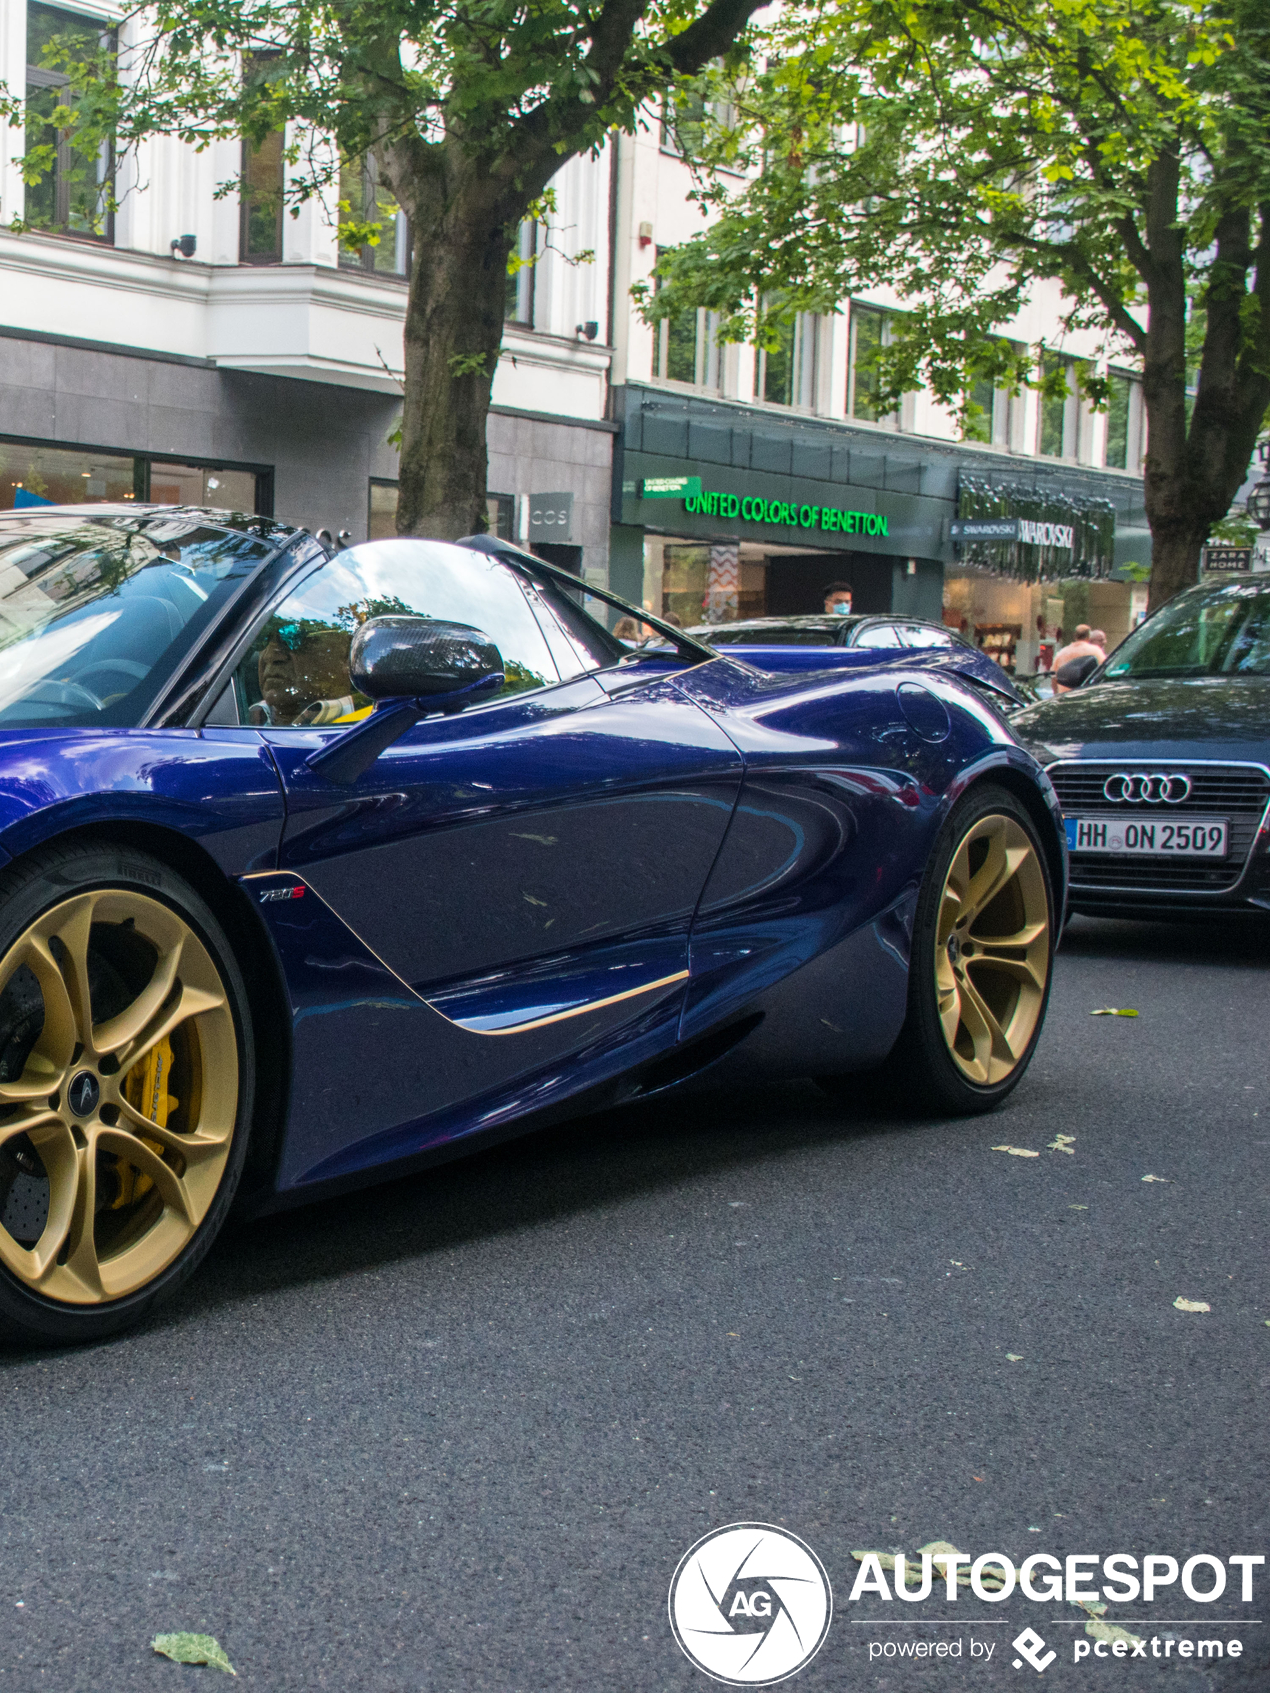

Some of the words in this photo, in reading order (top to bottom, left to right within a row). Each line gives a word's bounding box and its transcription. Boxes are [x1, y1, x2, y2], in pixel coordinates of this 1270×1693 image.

[532, 510, 567, 525] COS
[684, 491, 740, 518] UNITED
[741, 496, 798, 526] COLORS
[799, 504, 819, 528] OF
[963, 524, 1017, 535] SWAROVSKI
[1018, 518, 1074, 549] WAROVSKI
[1211, 551, 1246, 560] ZARA
[1210, 561, 1245, 569] HOME
[1079, 823, 1107, 847] HH
[1125, 824, 1155, 849] ON
[1160, 825, 1223, 851] 2509
[260, 885, 306, 903] 720S
